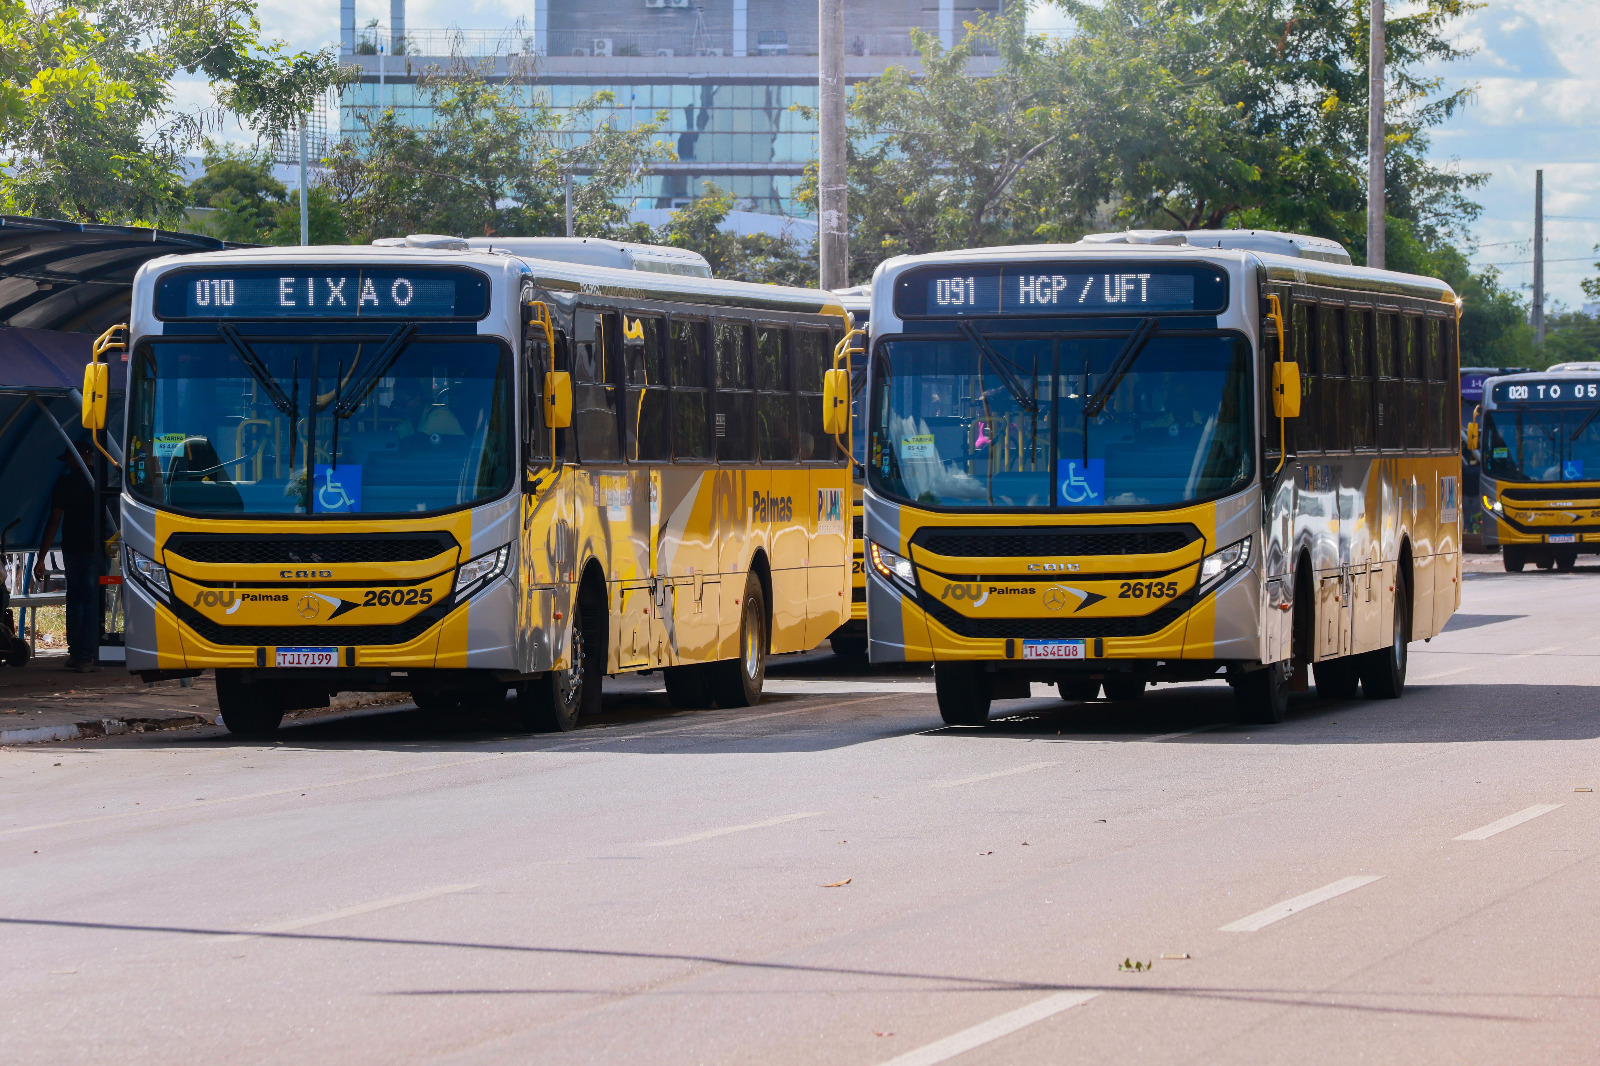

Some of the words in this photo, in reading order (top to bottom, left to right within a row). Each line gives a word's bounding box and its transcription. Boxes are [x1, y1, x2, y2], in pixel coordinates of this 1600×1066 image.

[196, 279, 234, 306] 010
[279, 277, 413, 306] EIXAO
[936, 277, 975, 305] 091
[1019, 275, 1067, 304] HGP
[1104, 273, 1151, 303] UFT
[1508, 386, 1528, 399] 020
[1574, 384, 1597, 398] 05
[753, 490, 792, 523] Palmas
[1028, 563, 1080, 571] CAIO
[280, 570, 332, 578] CAIO
[989, 587, 1036, 595] Palmas
[1118, 582, 1178, 599] 26135
[242, 593, 289, 602] Palmas
[362, 588, 433, 607] 26025
[1027, 645, 1079, 657] TLS4E08
[281, 653, 332, 665] TJI7I99
